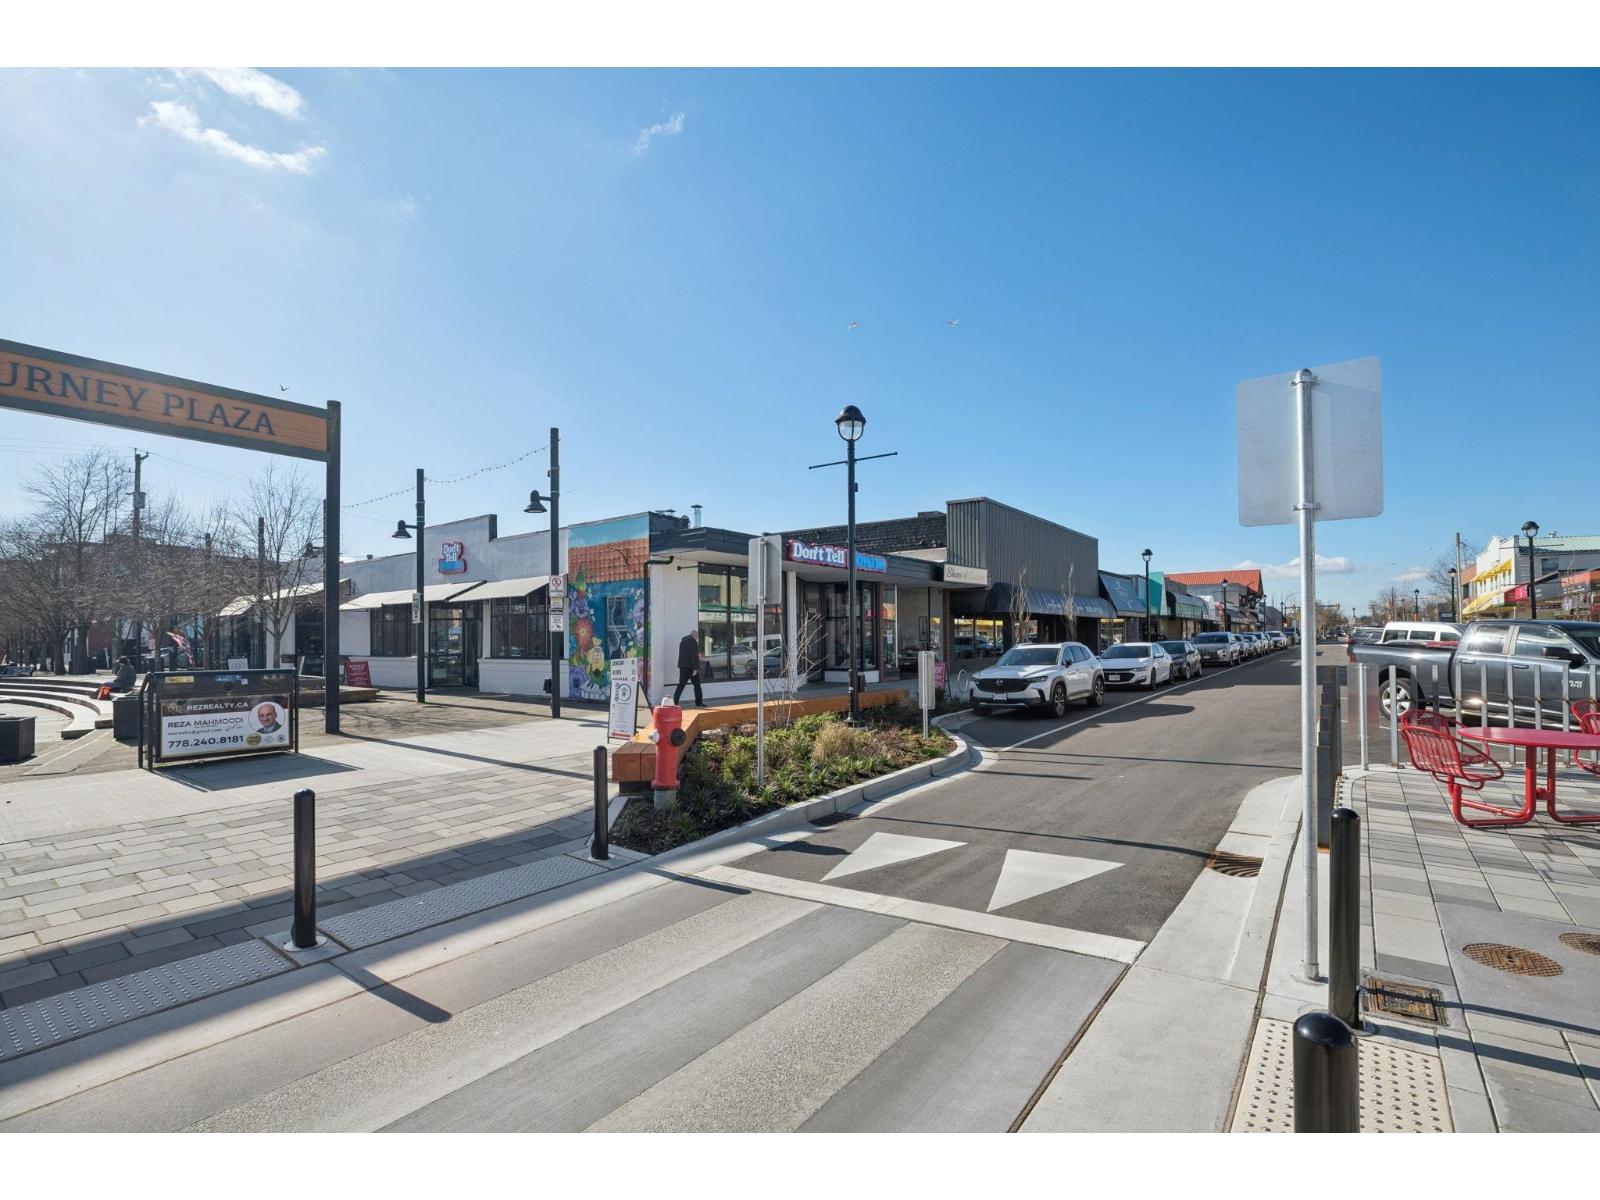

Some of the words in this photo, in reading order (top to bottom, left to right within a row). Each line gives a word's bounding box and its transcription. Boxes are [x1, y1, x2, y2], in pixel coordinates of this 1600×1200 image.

[160, 391, 276, 436] PLAZA
[793, 542, 824, 561] Don't
[825, 547, 845, 564] Tell
[187, 702, 248, 711] REZREALTY.CA
[194, 717, 243, 726] MAHMOODI
[168, 735, 243, 748] 778.240.8181
